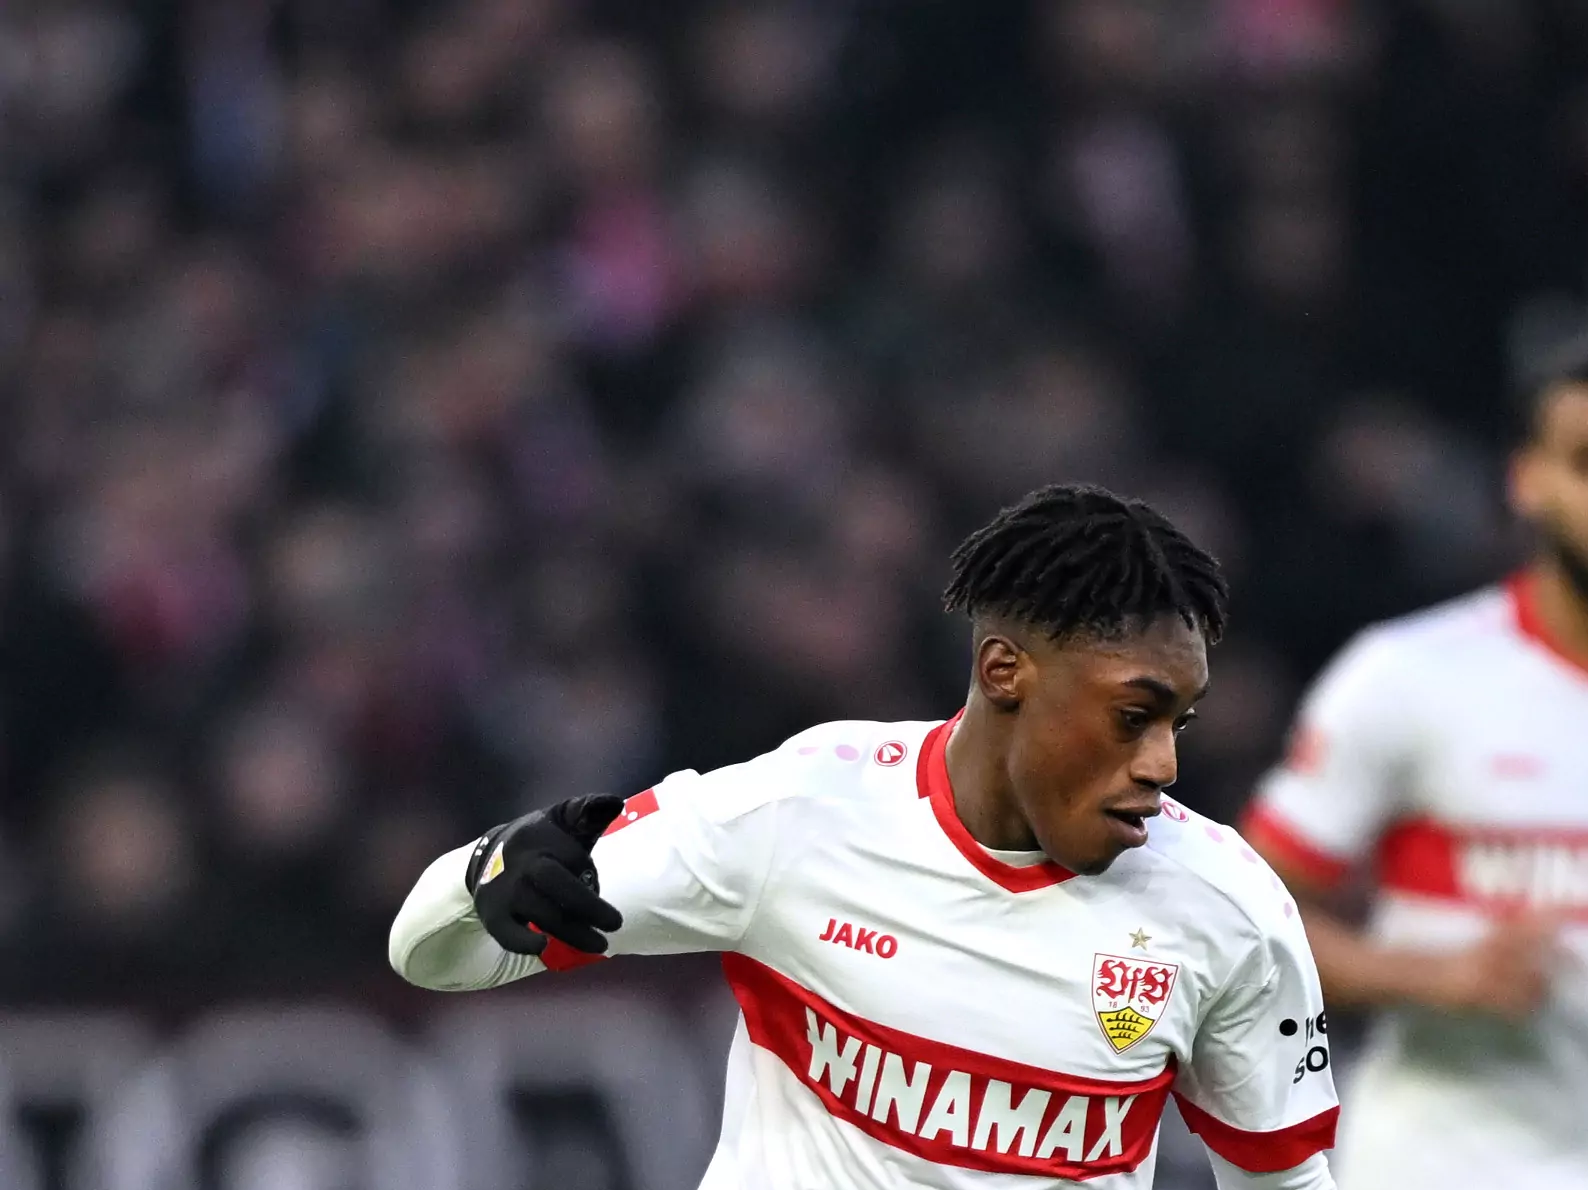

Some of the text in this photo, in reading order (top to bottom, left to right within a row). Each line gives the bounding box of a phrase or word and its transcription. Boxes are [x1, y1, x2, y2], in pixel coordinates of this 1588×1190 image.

[818, 918, 899, 960] JAKO
[1096, 959, 1174, 1005] VfB
[805, 1005, 1139, 1162] WINAMAX
